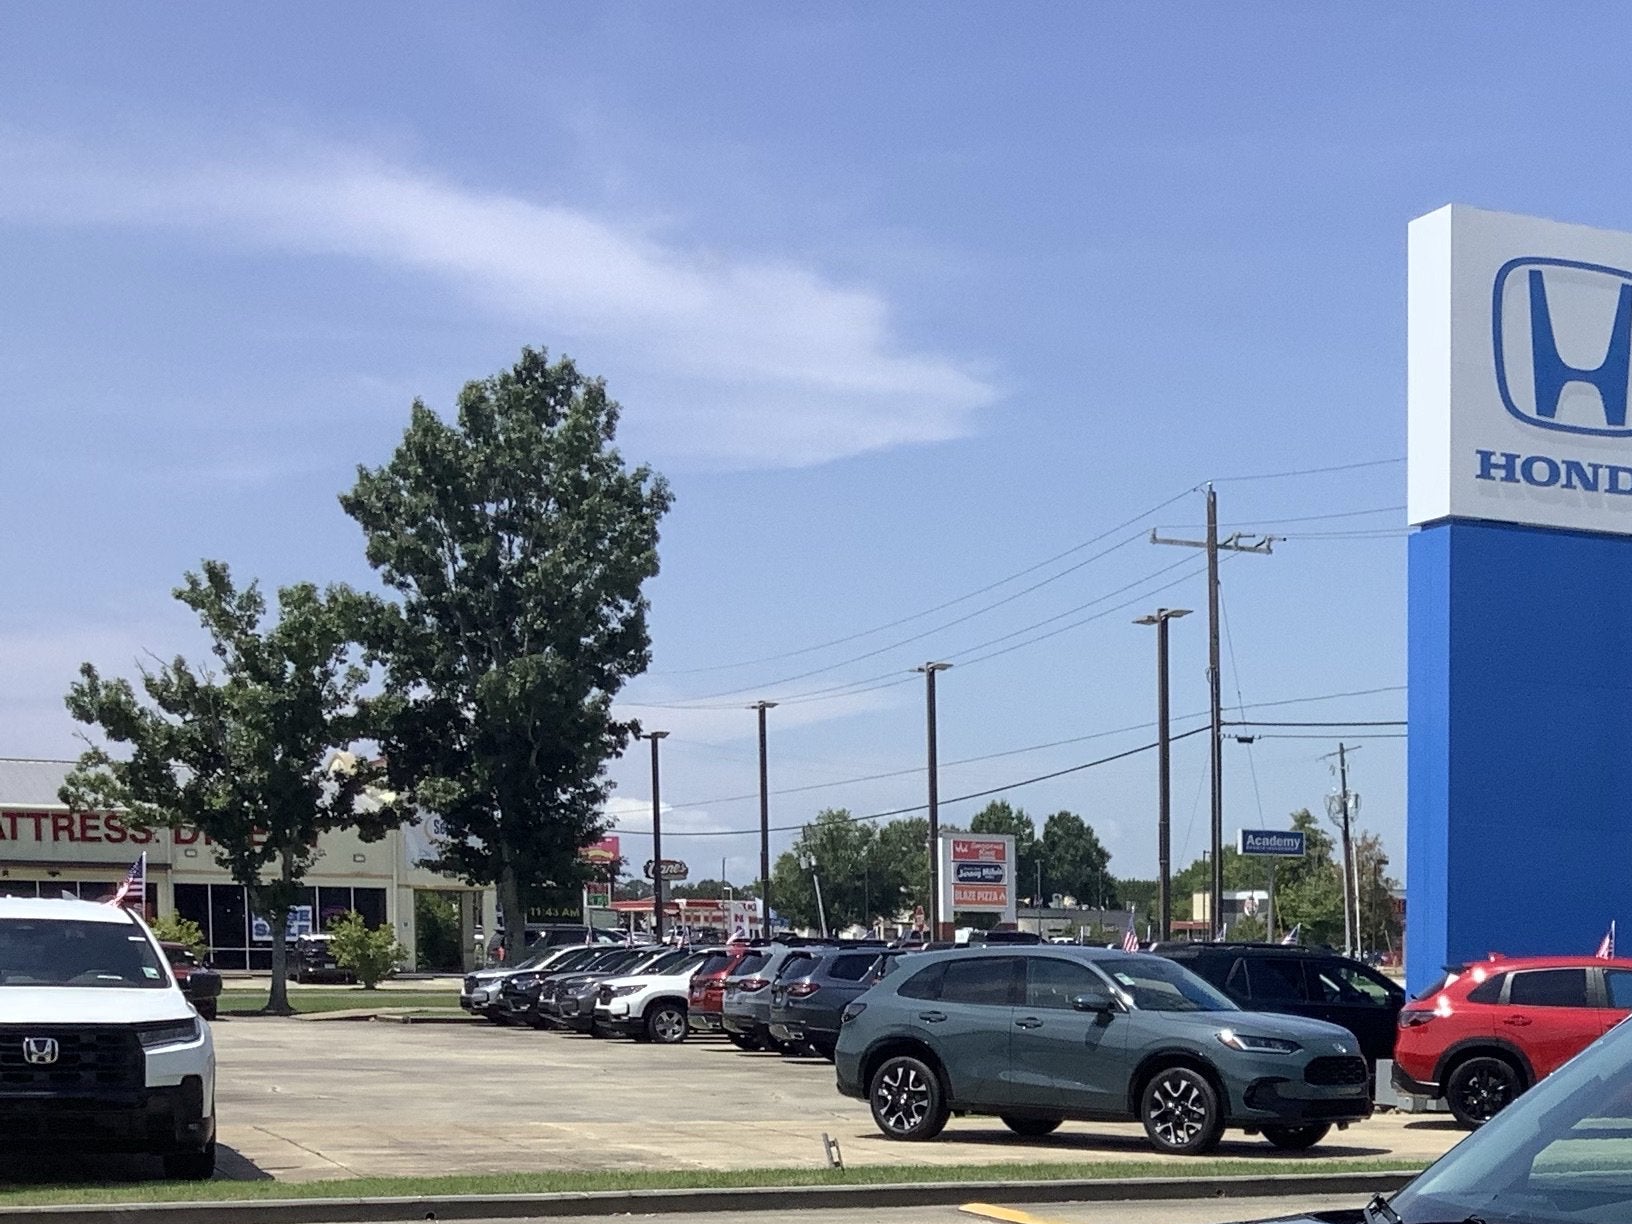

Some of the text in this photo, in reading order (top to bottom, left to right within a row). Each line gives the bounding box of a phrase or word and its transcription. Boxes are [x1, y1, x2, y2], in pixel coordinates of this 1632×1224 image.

[0, 811, 153, 844] TTRESS
[1246, 834, 1301, 850] Academy
[976, 891, 998, 901] PIZZA
[561, 907, 580, 917] AM
